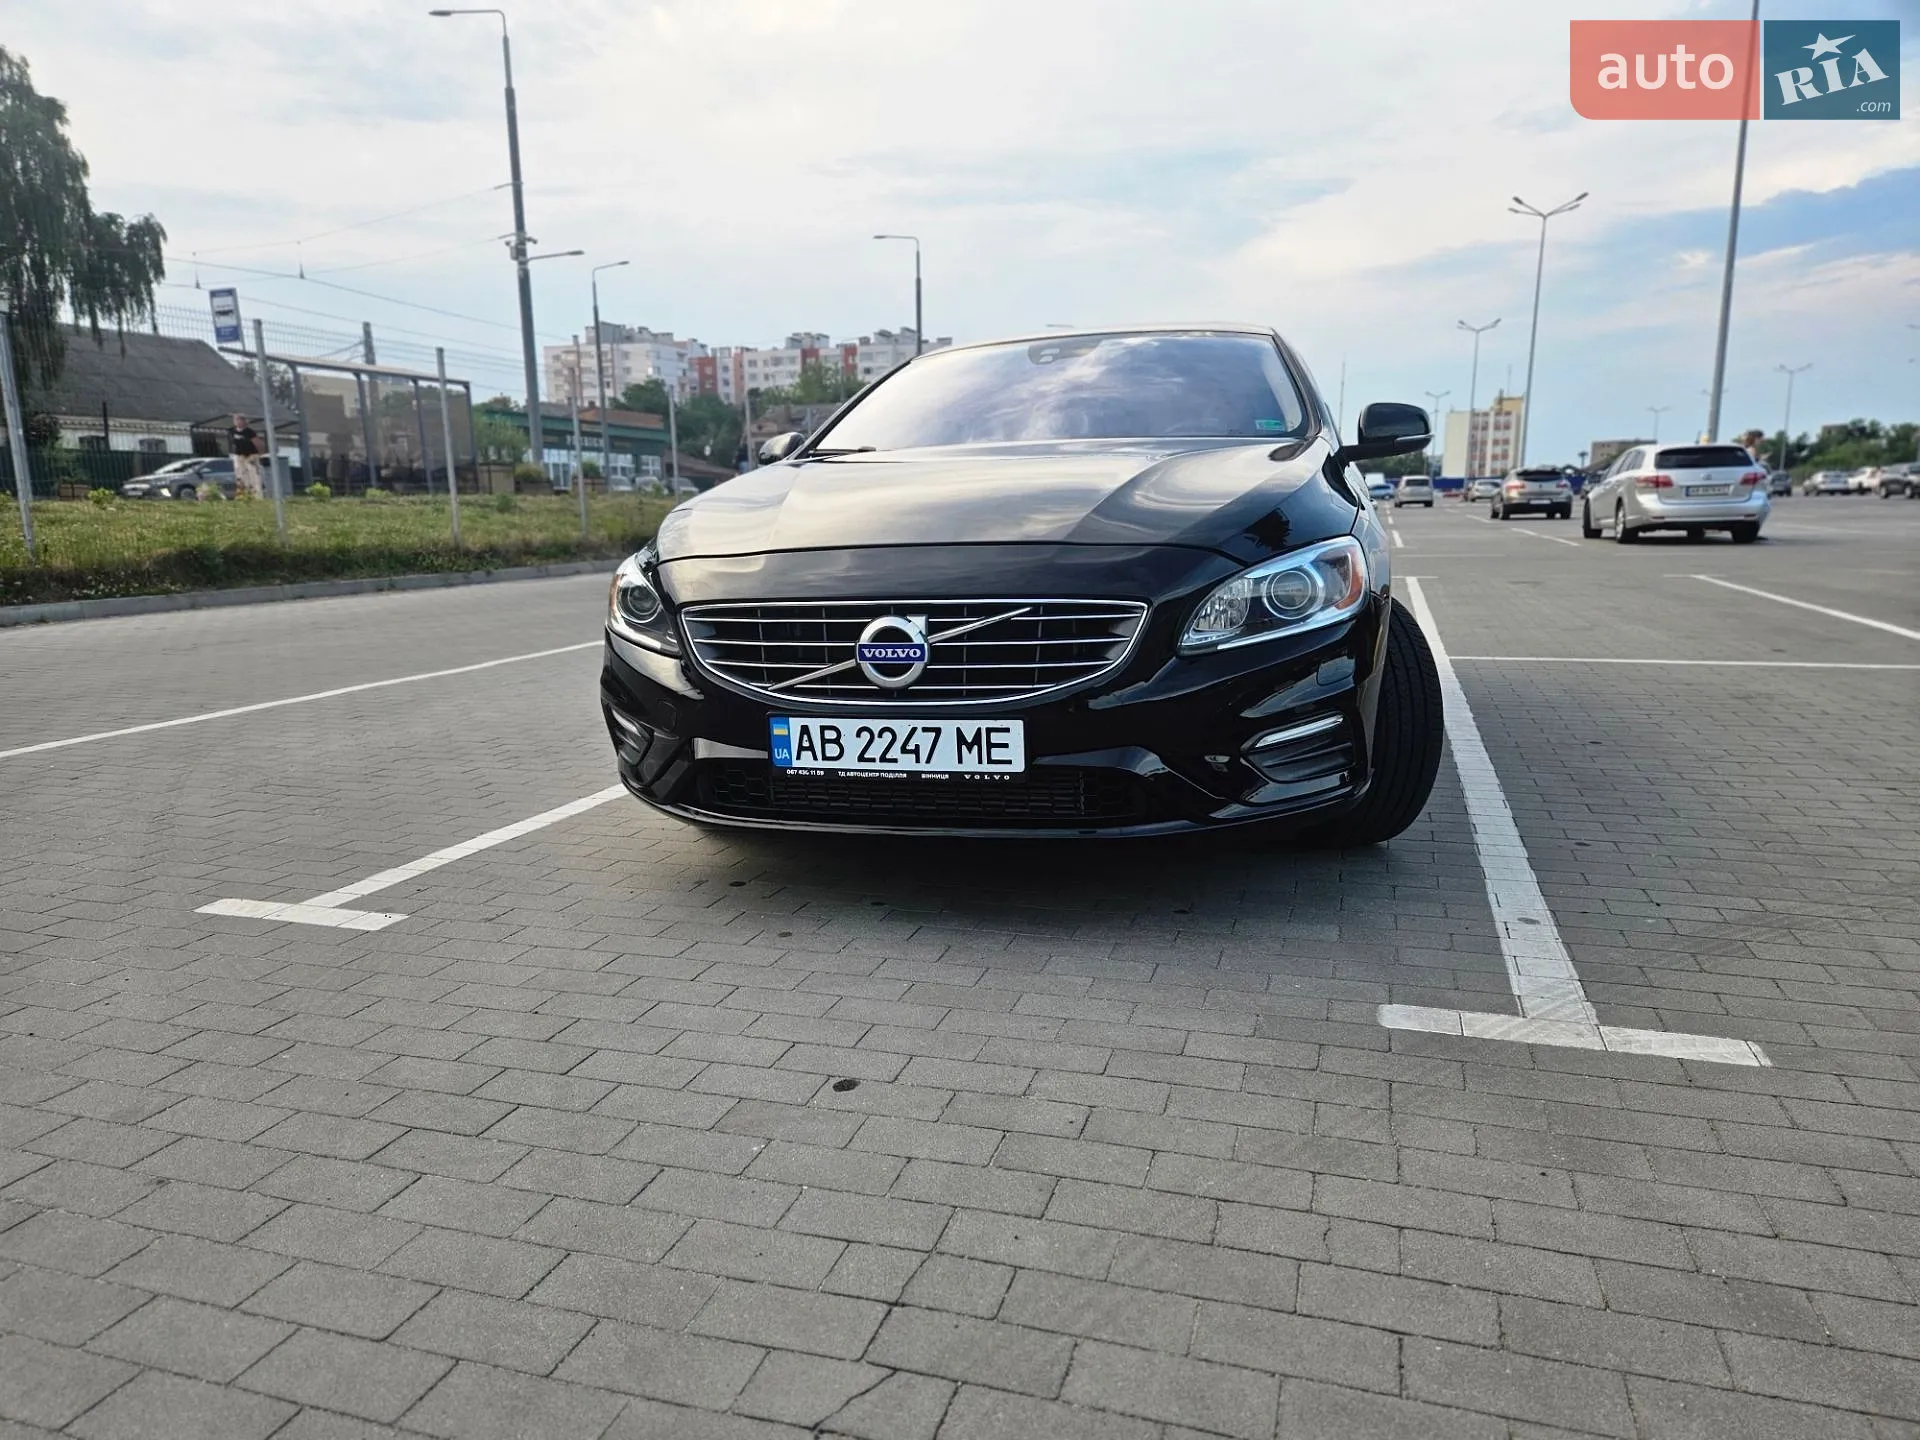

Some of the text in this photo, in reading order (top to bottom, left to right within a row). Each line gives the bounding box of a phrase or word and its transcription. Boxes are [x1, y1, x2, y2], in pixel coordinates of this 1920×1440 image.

[861, 648, 921, 658] VOLVO
[796, 724, 1013, 765] AB 2247 ME
[774, 748, 790, 759] UA
